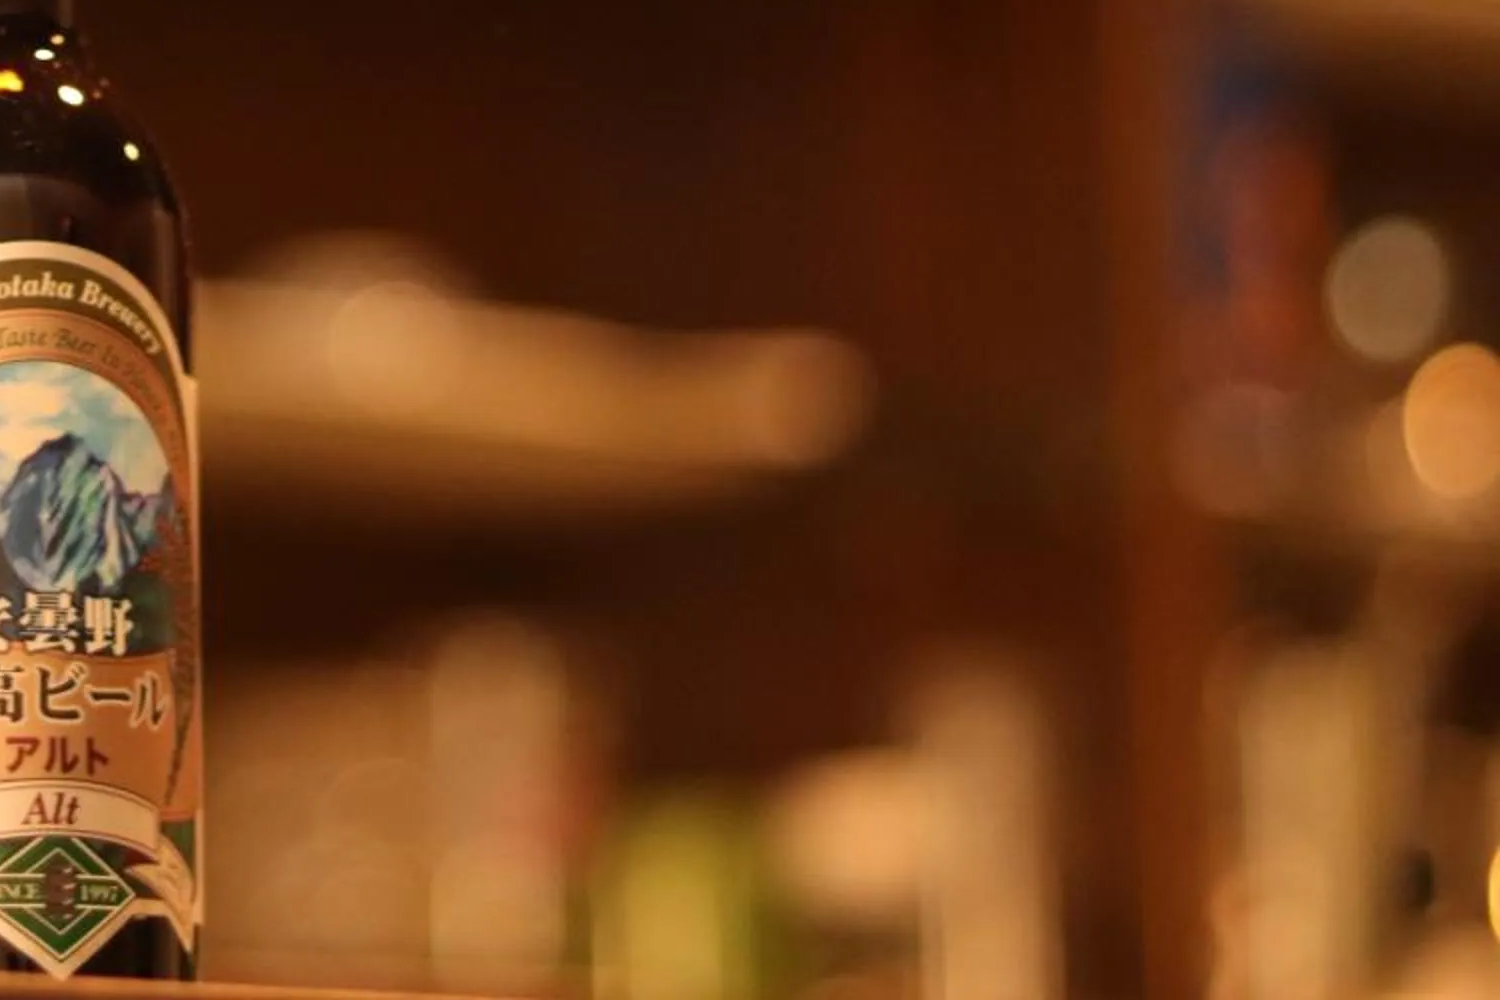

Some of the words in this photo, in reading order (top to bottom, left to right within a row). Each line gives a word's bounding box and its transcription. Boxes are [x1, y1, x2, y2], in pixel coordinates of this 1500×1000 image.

[79, 279, 164, 356] Brewery
[52, 327, 97, 355] Beer
[5, 736, 111, 777] アルト
[20, 791, 81, 826] Alt
